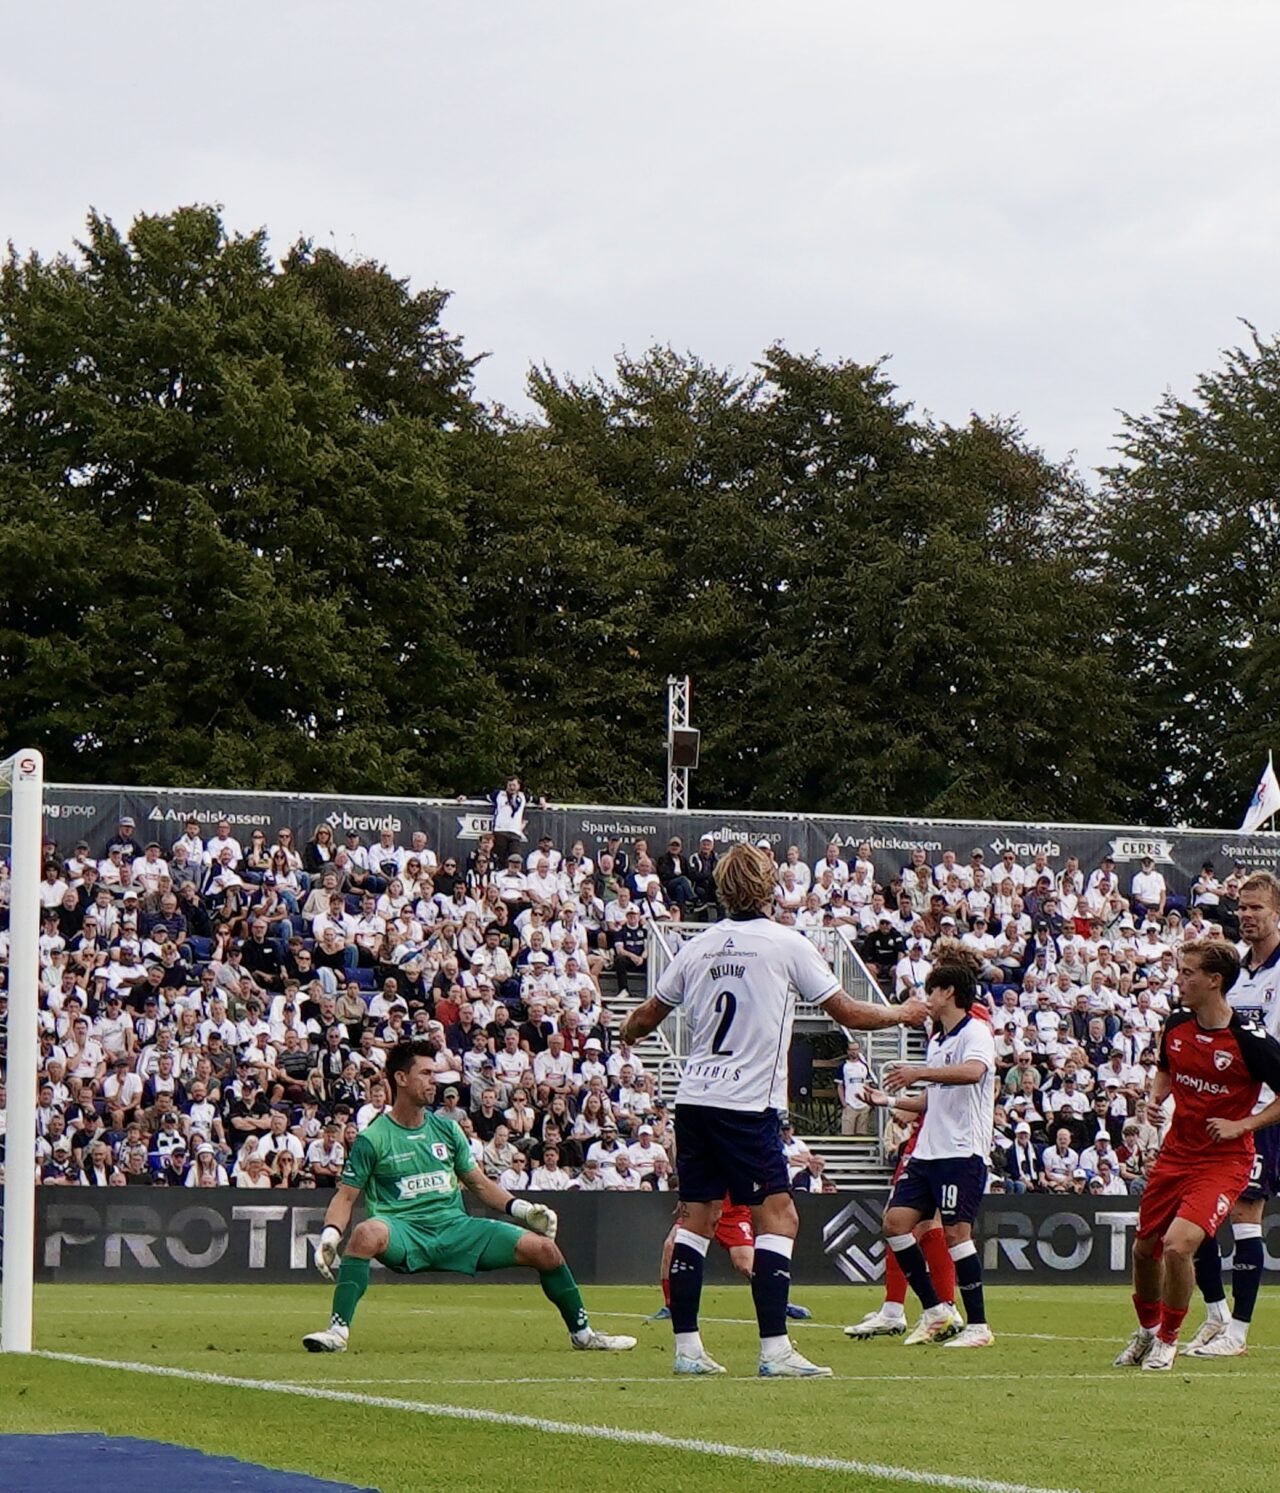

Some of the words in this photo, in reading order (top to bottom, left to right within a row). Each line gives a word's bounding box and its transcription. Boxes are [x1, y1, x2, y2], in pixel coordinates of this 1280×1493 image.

[62, 806, 96, 819] group
[165, 808, 271, 825] Andelskassen
[342, 814, 401, 831] bravida
[709, 827, 749, 844] alling
[1122, 842, 1162, 855] CERES
[712, 991, 737, 1056] 2
[1175, 1072, 1231, 1095] MONJASA
[407, 1175, 446, 1191] CERES
[941, 1184, 959, 1209] 19
